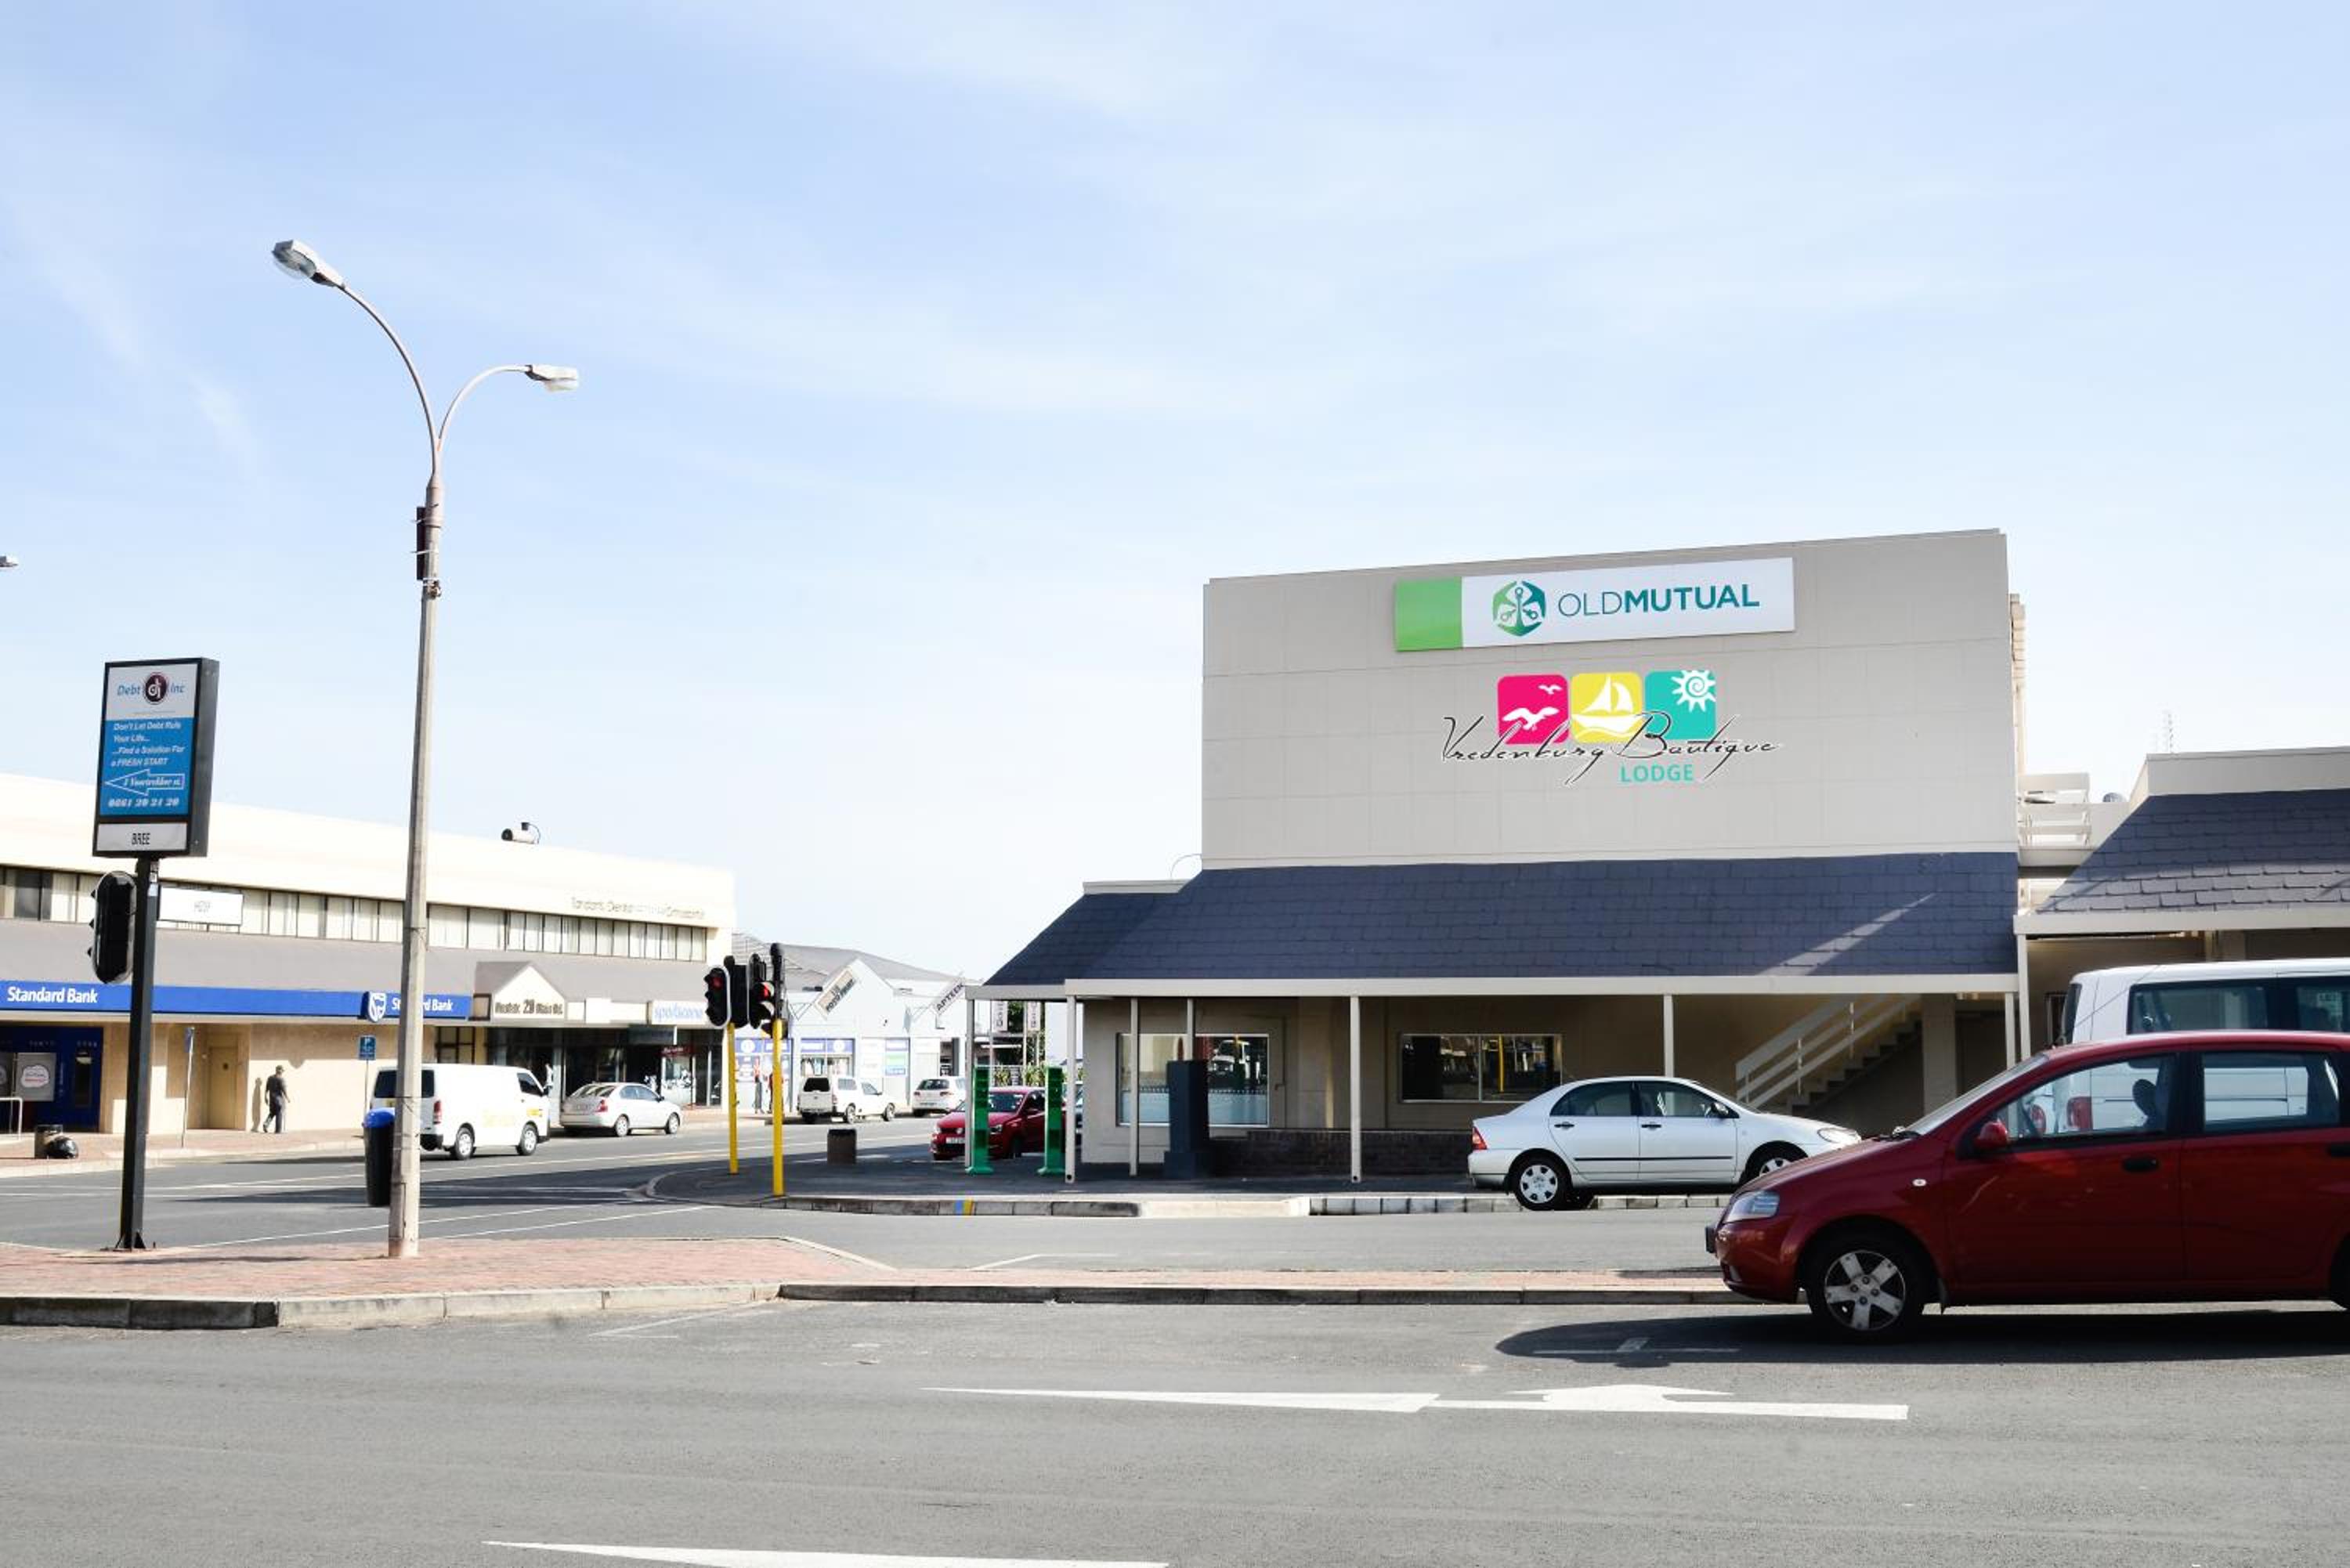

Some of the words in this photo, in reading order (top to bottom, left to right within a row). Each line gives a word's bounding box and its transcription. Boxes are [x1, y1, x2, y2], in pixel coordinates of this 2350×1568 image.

[1443, 715, 1604, 784] Vredenburg
[1611, 710, 1777, 779] Boutique
[1620, 764, 1694, 782] LODGE
[7, 985, 66, 1003] Standard
[67, 987, 98, 1003] Bank
[936, 982, 965, 1012] APTEEK
[432, 998, 454, 1011] Bank
